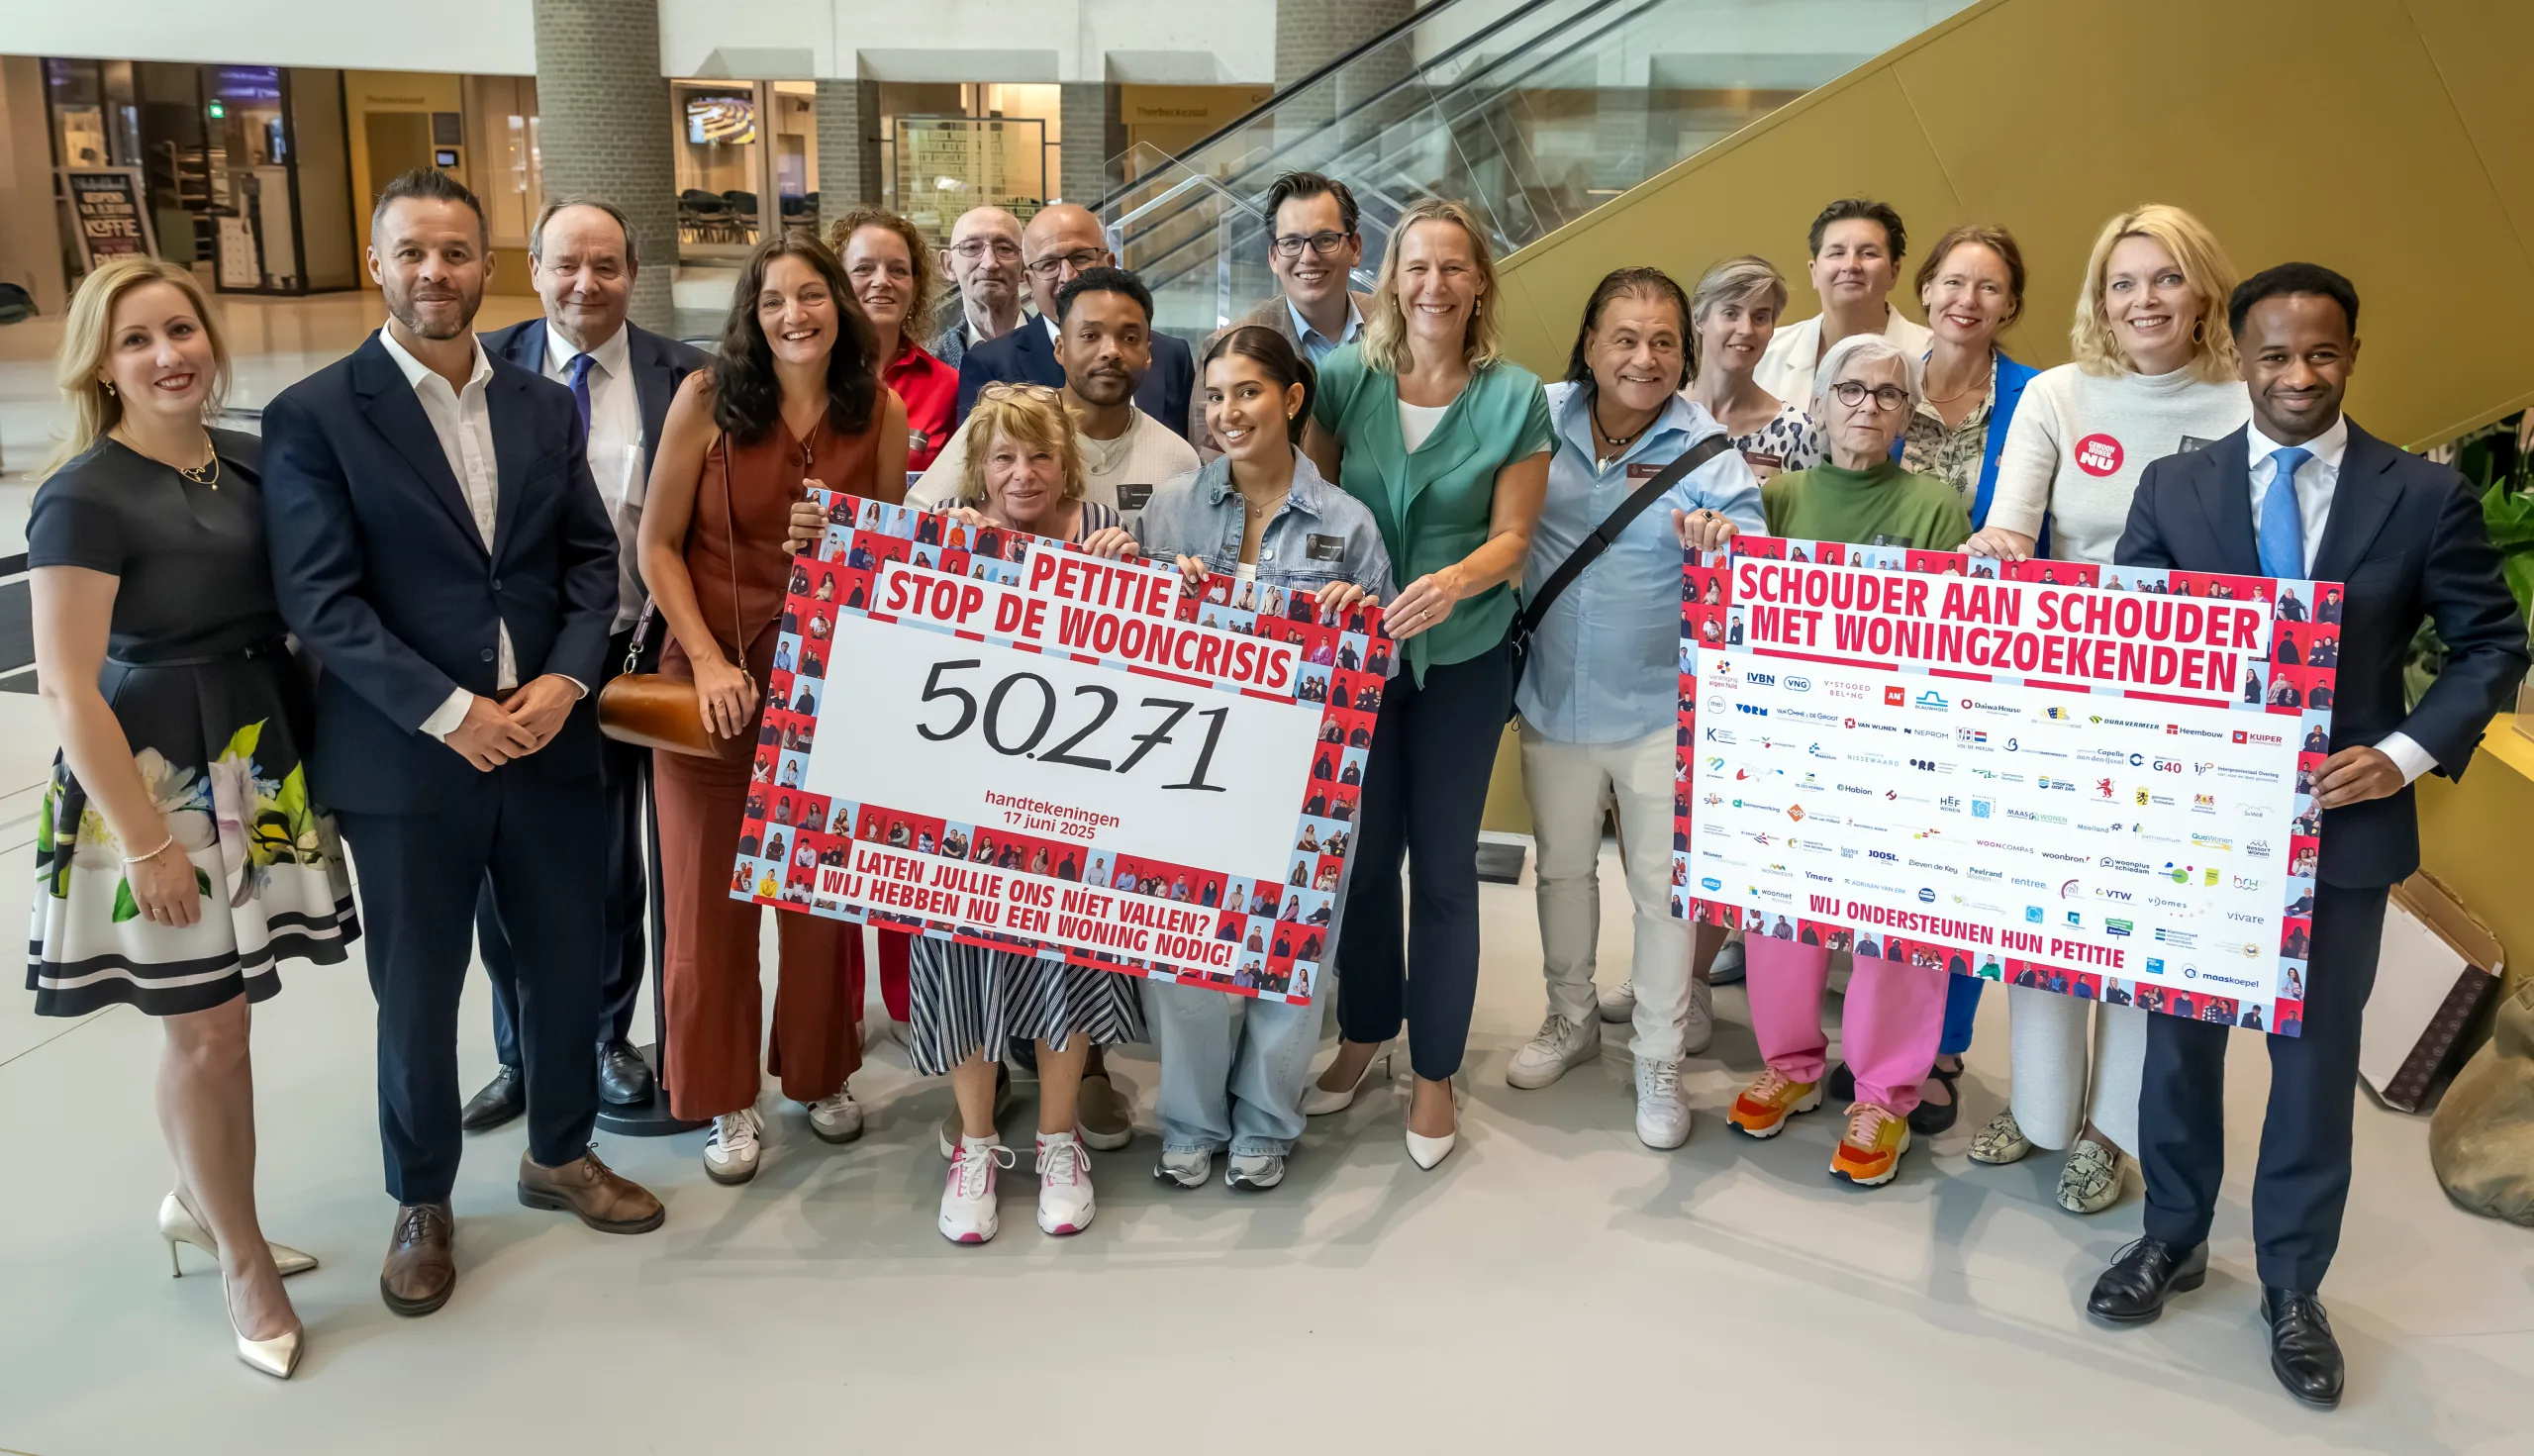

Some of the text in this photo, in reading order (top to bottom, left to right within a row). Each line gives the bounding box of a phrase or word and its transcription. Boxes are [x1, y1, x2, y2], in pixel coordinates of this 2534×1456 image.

[2080, 451, 2114, 471] NU
[1029, 552, 1172, 618] PETITIE
[1739, 562, 2260, 649] SCHOUDER AAN SCHOUDER
[887, 570, 1292, 689] STOP DE WOONCRISIS
[1750, 604, 2237, 693] MET WONINGZOEKENDEN
[1747, 672, 1775, 685] IVBN
[1788, 679, 1807, 689] VNG
[1736, 703, 1768, 717] VORM
[1998, 705, 2021, 714] House
[916, 659, 1229, 792] 50.271
[1872, 724, 1897, 732] WIJNEN
[1914, 728, 1948, 739] NEPROM
[2180, 728, 2223, 738] Heembouw
[2250, 733, 2283, 743] KUIPER
[2097, 748, 2124, 758] Capelle
[1847, 754, 1899, 766] NISSEWAARD
[2153, 760, 2182, 774] G40
[1845, 785, 1873, 796] Habion
[1940, 796, 1960, 808] HEF
[985, 790, 1120, 828] handtekeningen
[1004, 811, 1095, 839] 17 juni 2025
[2077, 824, 2108, 833] Mooiland
[2192, 833, 2233, 843] QuaWonen
[1976, 839, 2034, 854] WOONCOMPAS
[1944, 865, 1958, 875] Key
[2115, 859, 2150, 869] woonplus
[2115, 865, 2150, 875] schiedam
[1805, 871, 1833, 883] Ymere
[1970, 867, 2003, 879] Peelrand
[855, 849, 925, 883] LATEN
[930, 865, 1003, 899] JULLIE
[1009, 879, 1055, 909] ONS
[1120, 901, 1210, 936] VALLEN?
[1852, 879, 1880, 890] ADRIAAN
[1895, 885, 1906, 894] ERK
[1762, 889, 1792, 900] woonnet
[2106, 890, 2132, 901] VTW
[823, 869, 1233, 968] WIJ HEBBEN NU EEN WONING NODIG!
[2227, 913, 2265, 924] vivare
[1809, 894, 1841, 917] WIJ
[1847, 901, 1994, 944] ONDERSTEUNEN
[2001, 928, 2043, 954] HUN
[2051, 938, 2124, 968] PETITIE
[2202, 972, 2259, 988] maaskoepel
